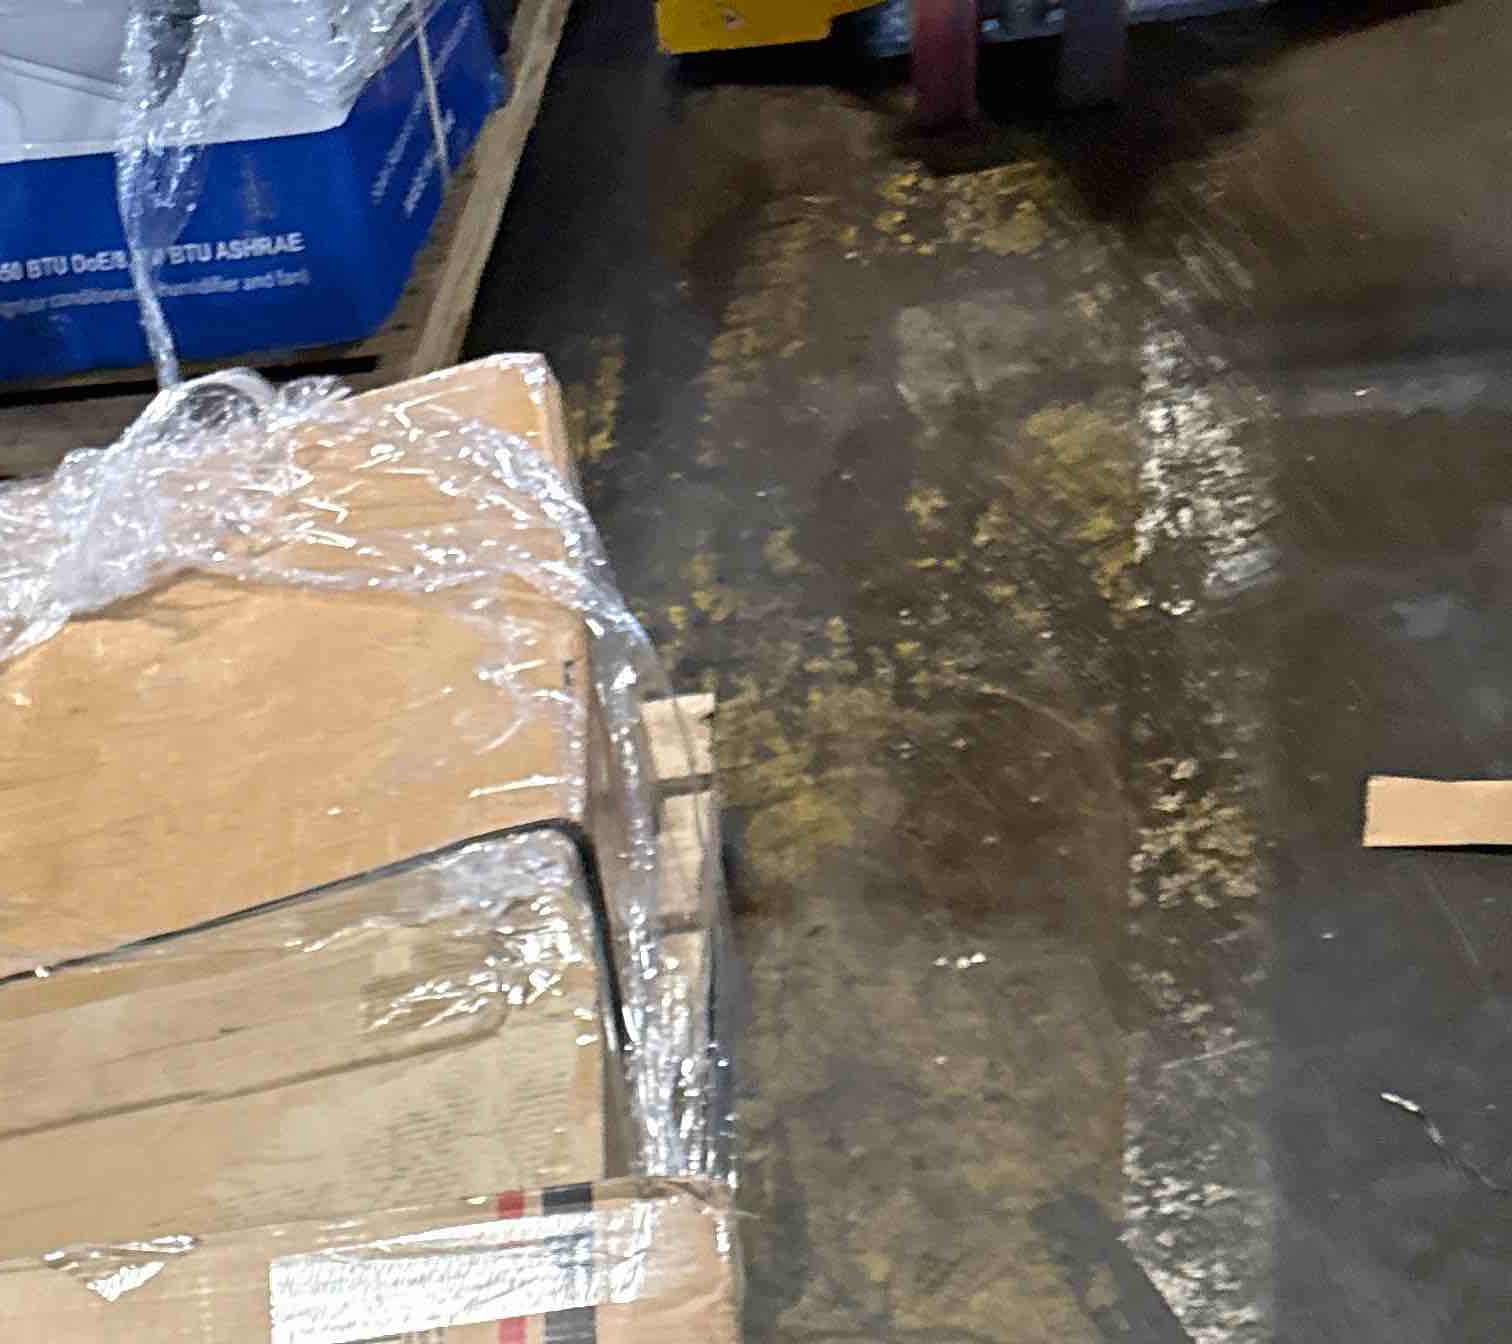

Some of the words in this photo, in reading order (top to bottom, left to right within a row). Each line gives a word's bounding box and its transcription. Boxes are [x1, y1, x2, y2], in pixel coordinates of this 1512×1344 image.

[26, 256, 68, 279] BTU
[170, 242, 212, 264] BTU
[216, 232, 305, 260] ASHRAE
